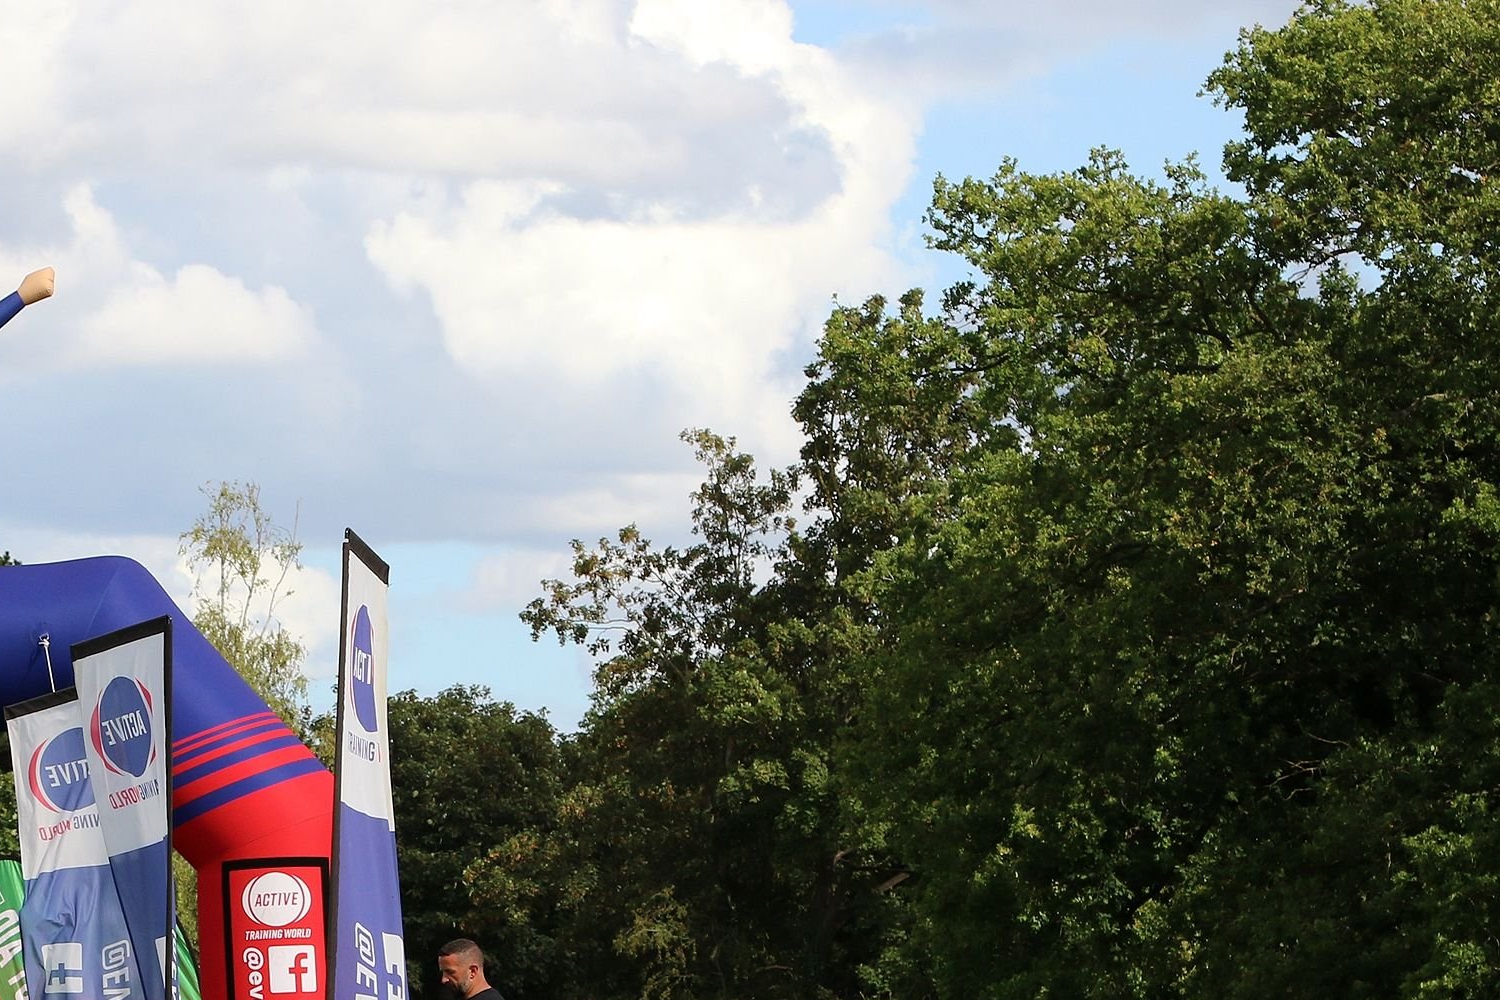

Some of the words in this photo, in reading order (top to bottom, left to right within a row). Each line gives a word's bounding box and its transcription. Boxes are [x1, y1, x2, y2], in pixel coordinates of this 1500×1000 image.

[254, 892, 299, 907] ACTIVE
[245, 929, 283, 941] TRAINING
[284, 928, 311, 939] WORLD
